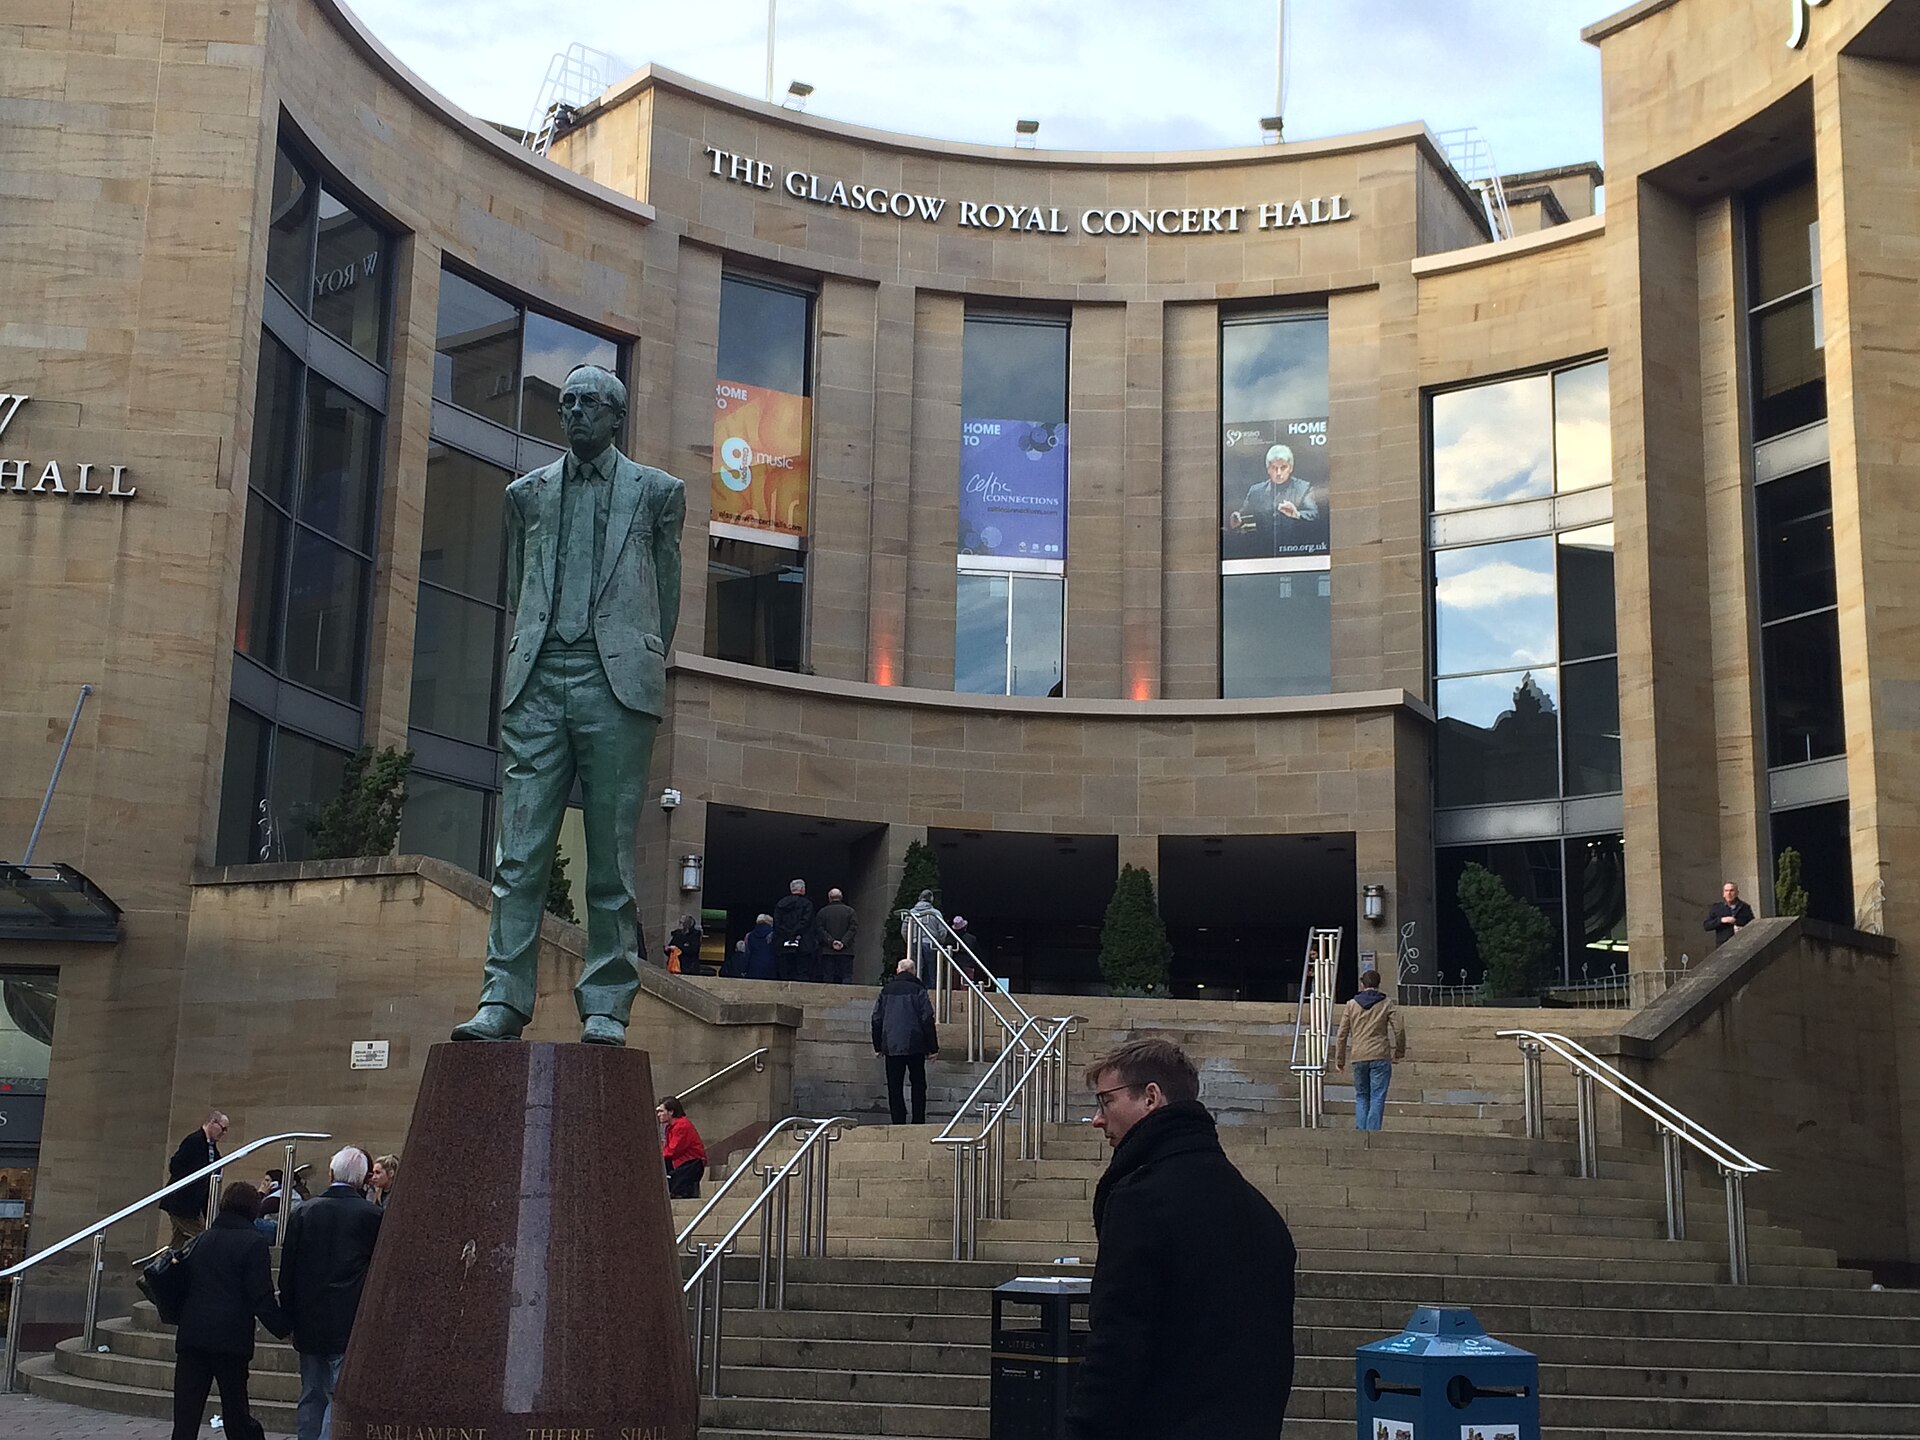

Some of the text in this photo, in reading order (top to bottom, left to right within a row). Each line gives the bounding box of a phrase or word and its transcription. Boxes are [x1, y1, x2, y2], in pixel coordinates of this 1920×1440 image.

[706, 145, 1352, 234] THE GLASGOW ROYAL CONCERT HALL
[715, 397, 728, 409] O
[963, 422, 1001, 435] HOME
[1288, 421, 1327, 434] HOME
[963, 435, 981, 446] TO
[1309, 434, 1327, 446] TO
[756, 452, 794, 470] music
[0, 459, 137, 496] HALL
[965, 471, 1012, 502] Celtic
[986, 494, 1060, 506] CONNECTIONS
[1279, 541, 1327, 553] rsno.org.uk
[366, 1423, 487, 1440] PARLIAMENT
[526, 1428, 596, 1440] THERE
[620, 1426, 668, 1440] SHALL
